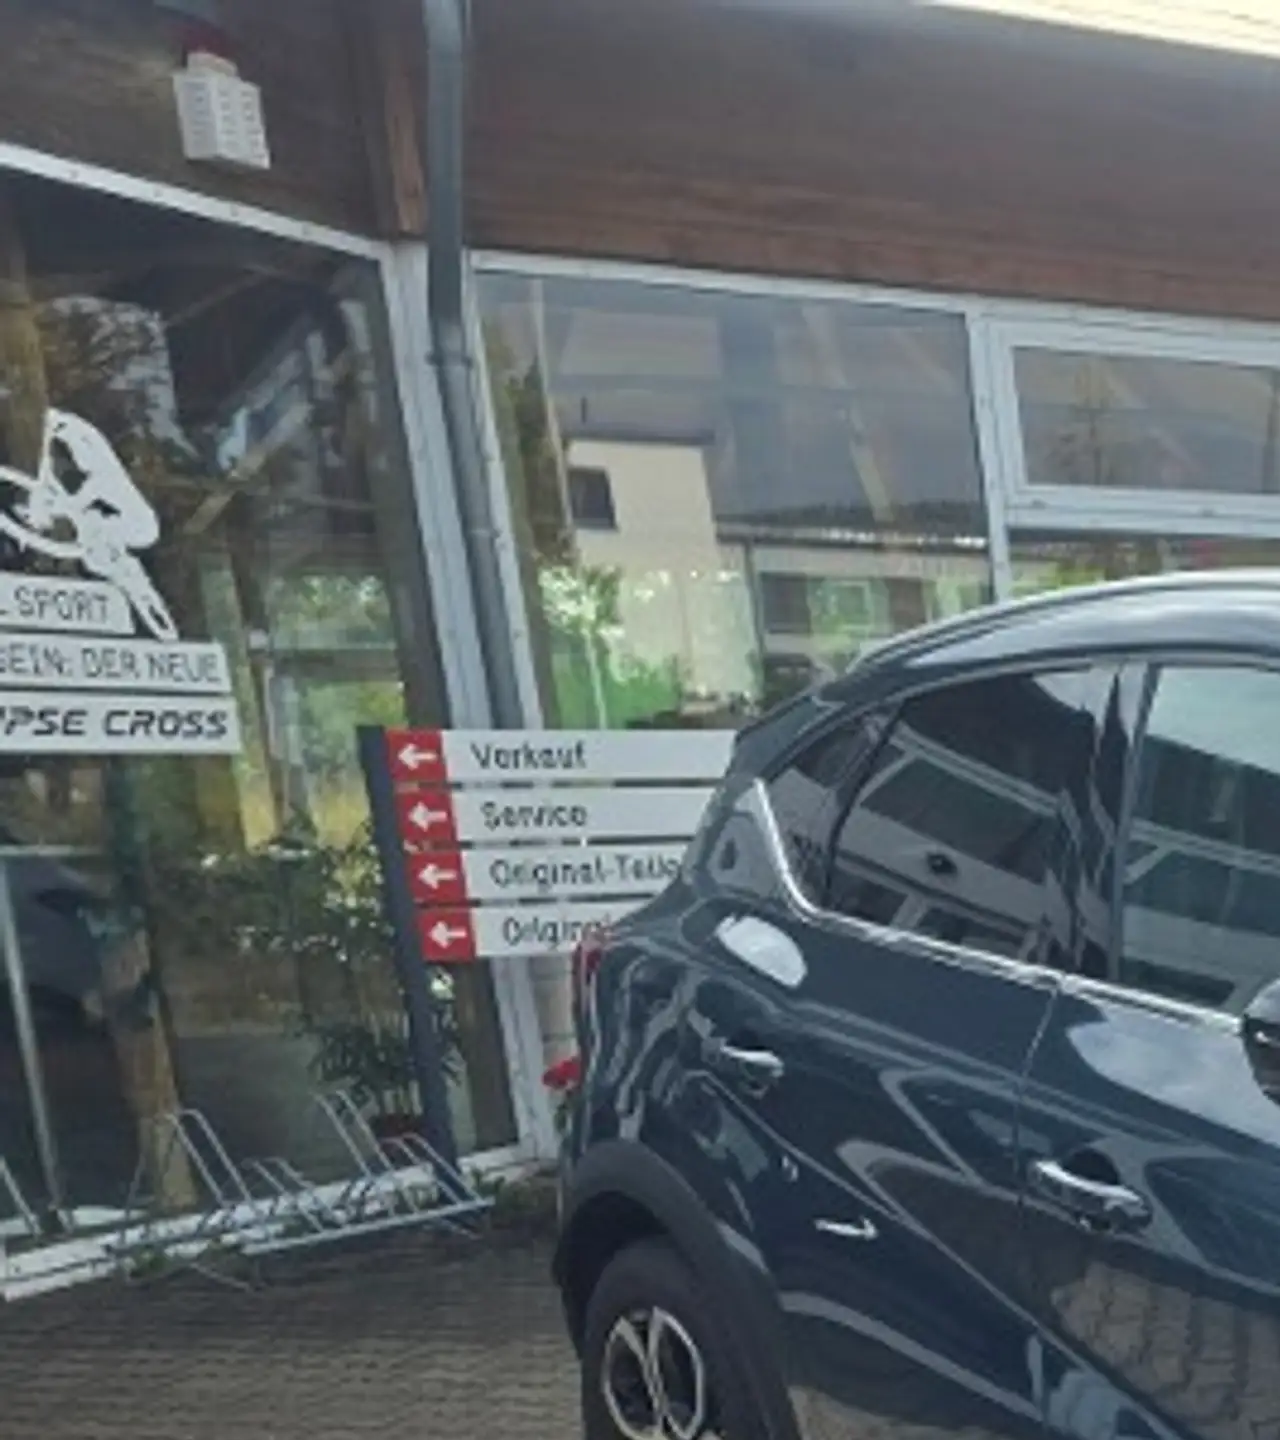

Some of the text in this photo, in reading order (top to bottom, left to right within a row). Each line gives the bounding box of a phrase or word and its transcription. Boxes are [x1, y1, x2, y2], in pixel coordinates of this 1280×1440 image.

[14, 585, 108, 622] SPORT
[81, 647, 141, 679] DER
[147, 652, 221, 683] NEUE
[104, 708, 228, 739] CROSS
[470, 739, 587, 770] Verkauf
[480, 800, 588, 830] Service
